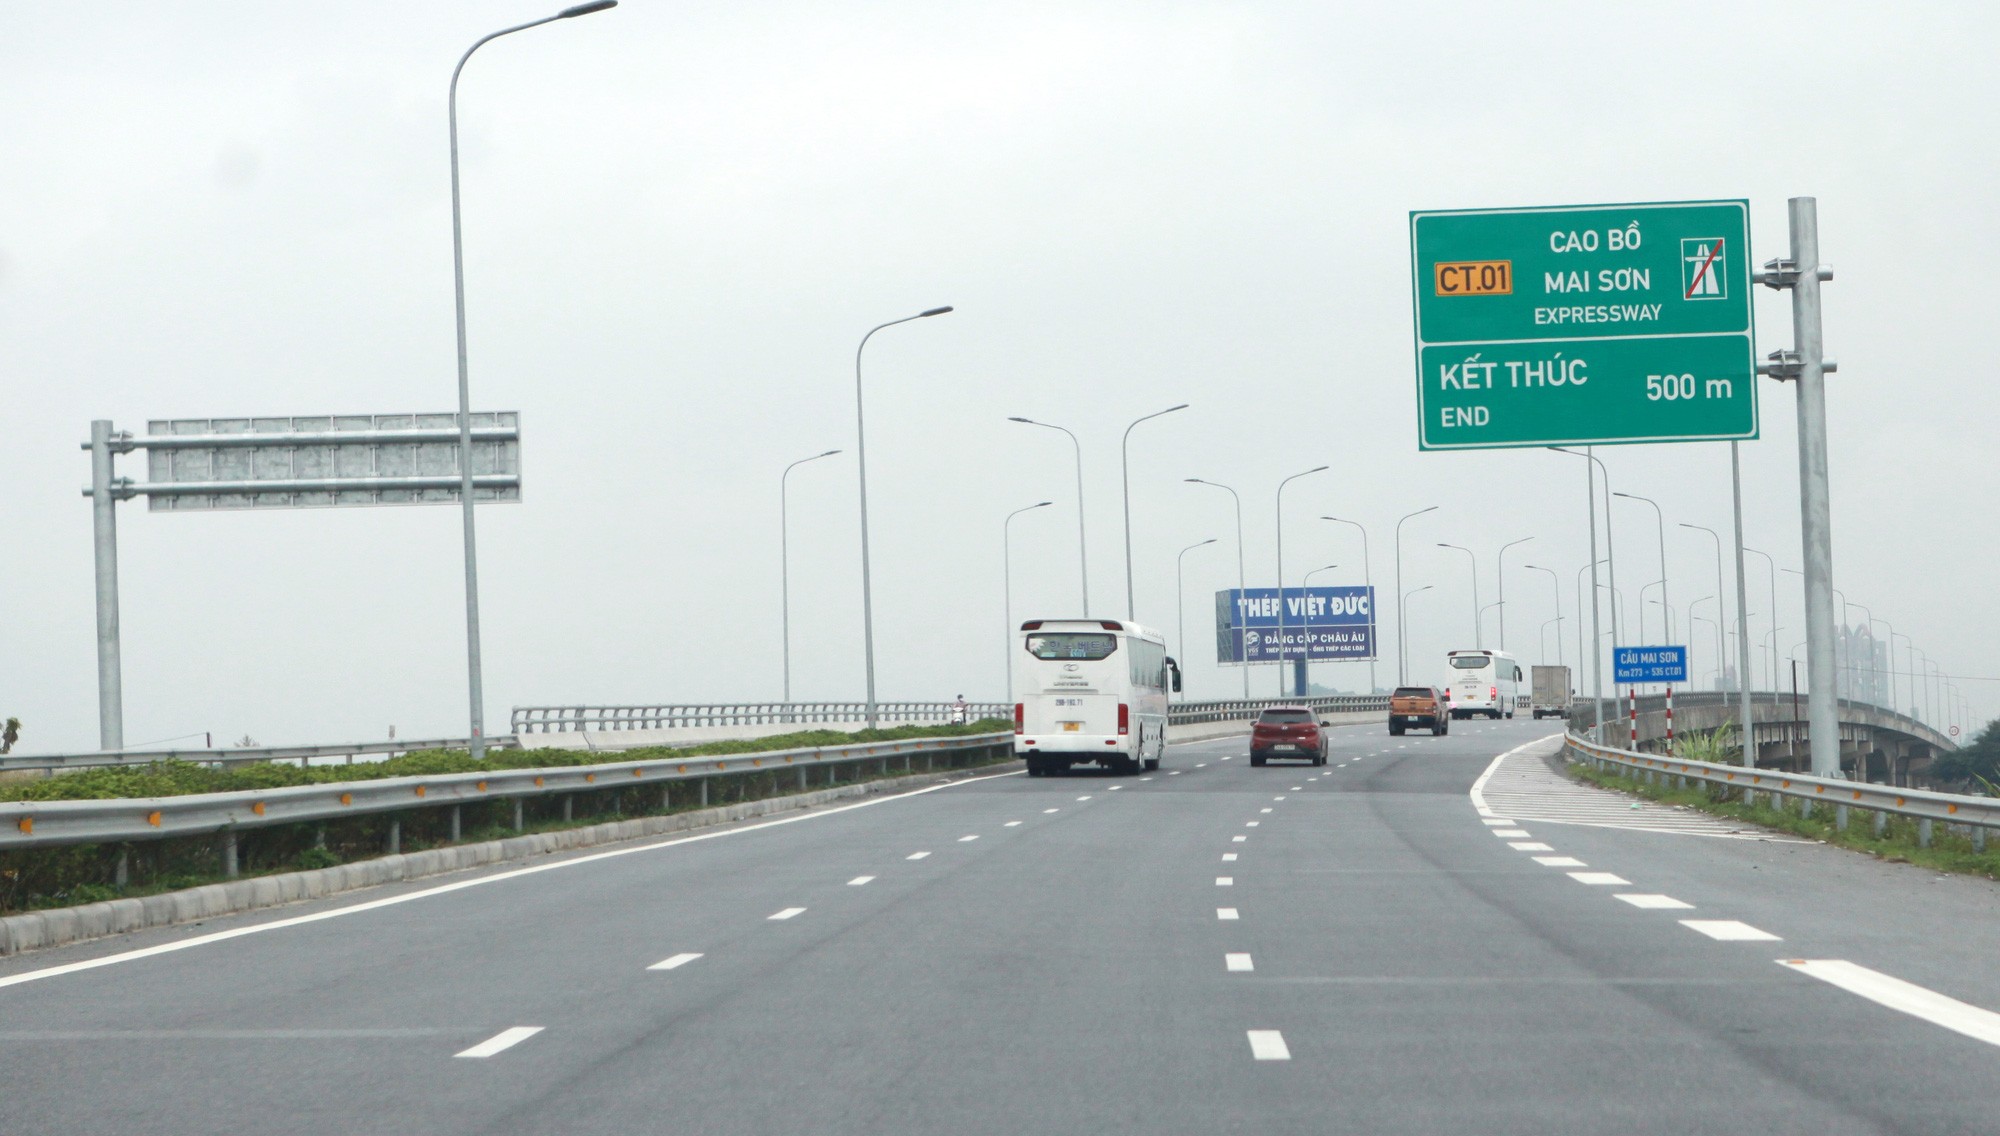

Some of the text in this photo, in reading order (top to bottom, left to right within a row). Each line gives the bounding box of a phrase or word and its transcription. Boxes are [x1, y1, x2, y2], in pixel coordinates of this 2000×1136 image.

[1550, 220, 1641, 253] CAO BỒ
[1440, 264, 1506, 292] CT.01
[1544, 267, 1650, 294] MAI SƠN
[1534, 303, 1662, 325] EXPRESSWAY
[1440, 352, 1588, 390] KẾT THÚC
[1646, 373, 1732, 401] 500 m
[1441, 406, 1490, 428] END
[1237, 592, 1369, 620] THÉP VIỆT ĐỨC
[1320, 631, 1349, 643] CHÂU
[1351, 631, 1365, 642] ÂU
[1621, 650, 1678, 664] CẦU MAI SƠN
